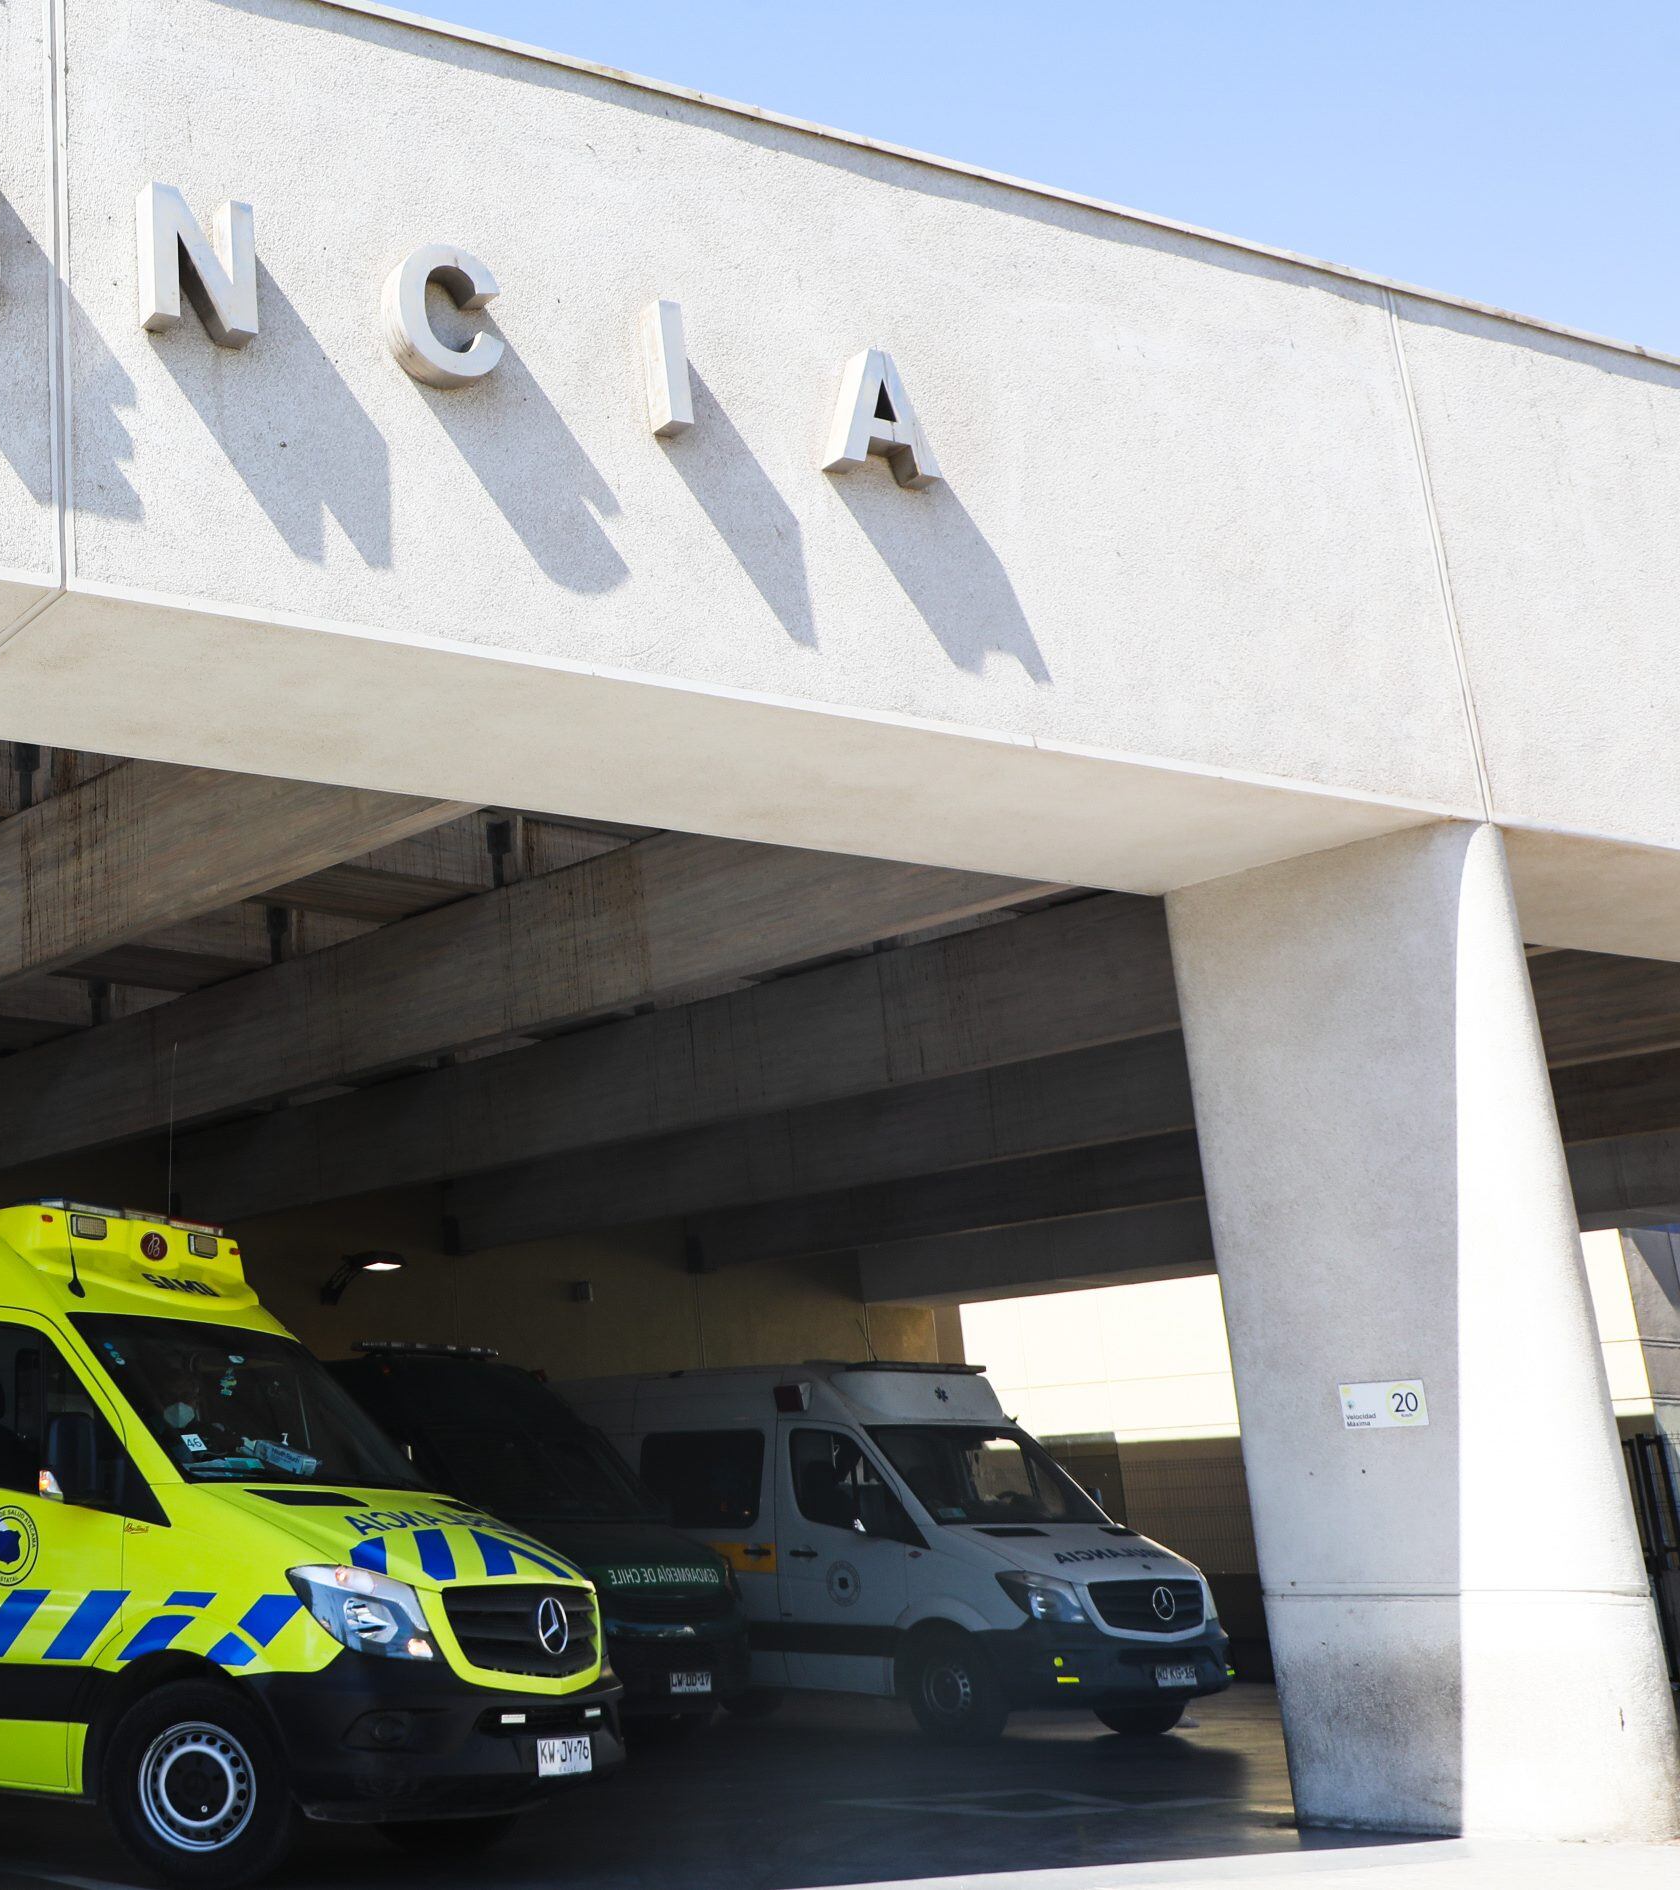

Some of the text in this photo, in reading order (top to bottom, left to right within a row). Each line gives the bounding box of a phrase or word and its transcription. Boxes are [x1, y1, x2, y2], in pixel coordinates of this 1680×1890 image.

[141, 1272, 221, 1298] SAMU
[1391, 1391, 1419, 1413] 20
[185, 1437, 203, 1450] 46
[7, 1509, 25, 1520] SALUD
[24, 1517, 37, 1549] ATACAMA
